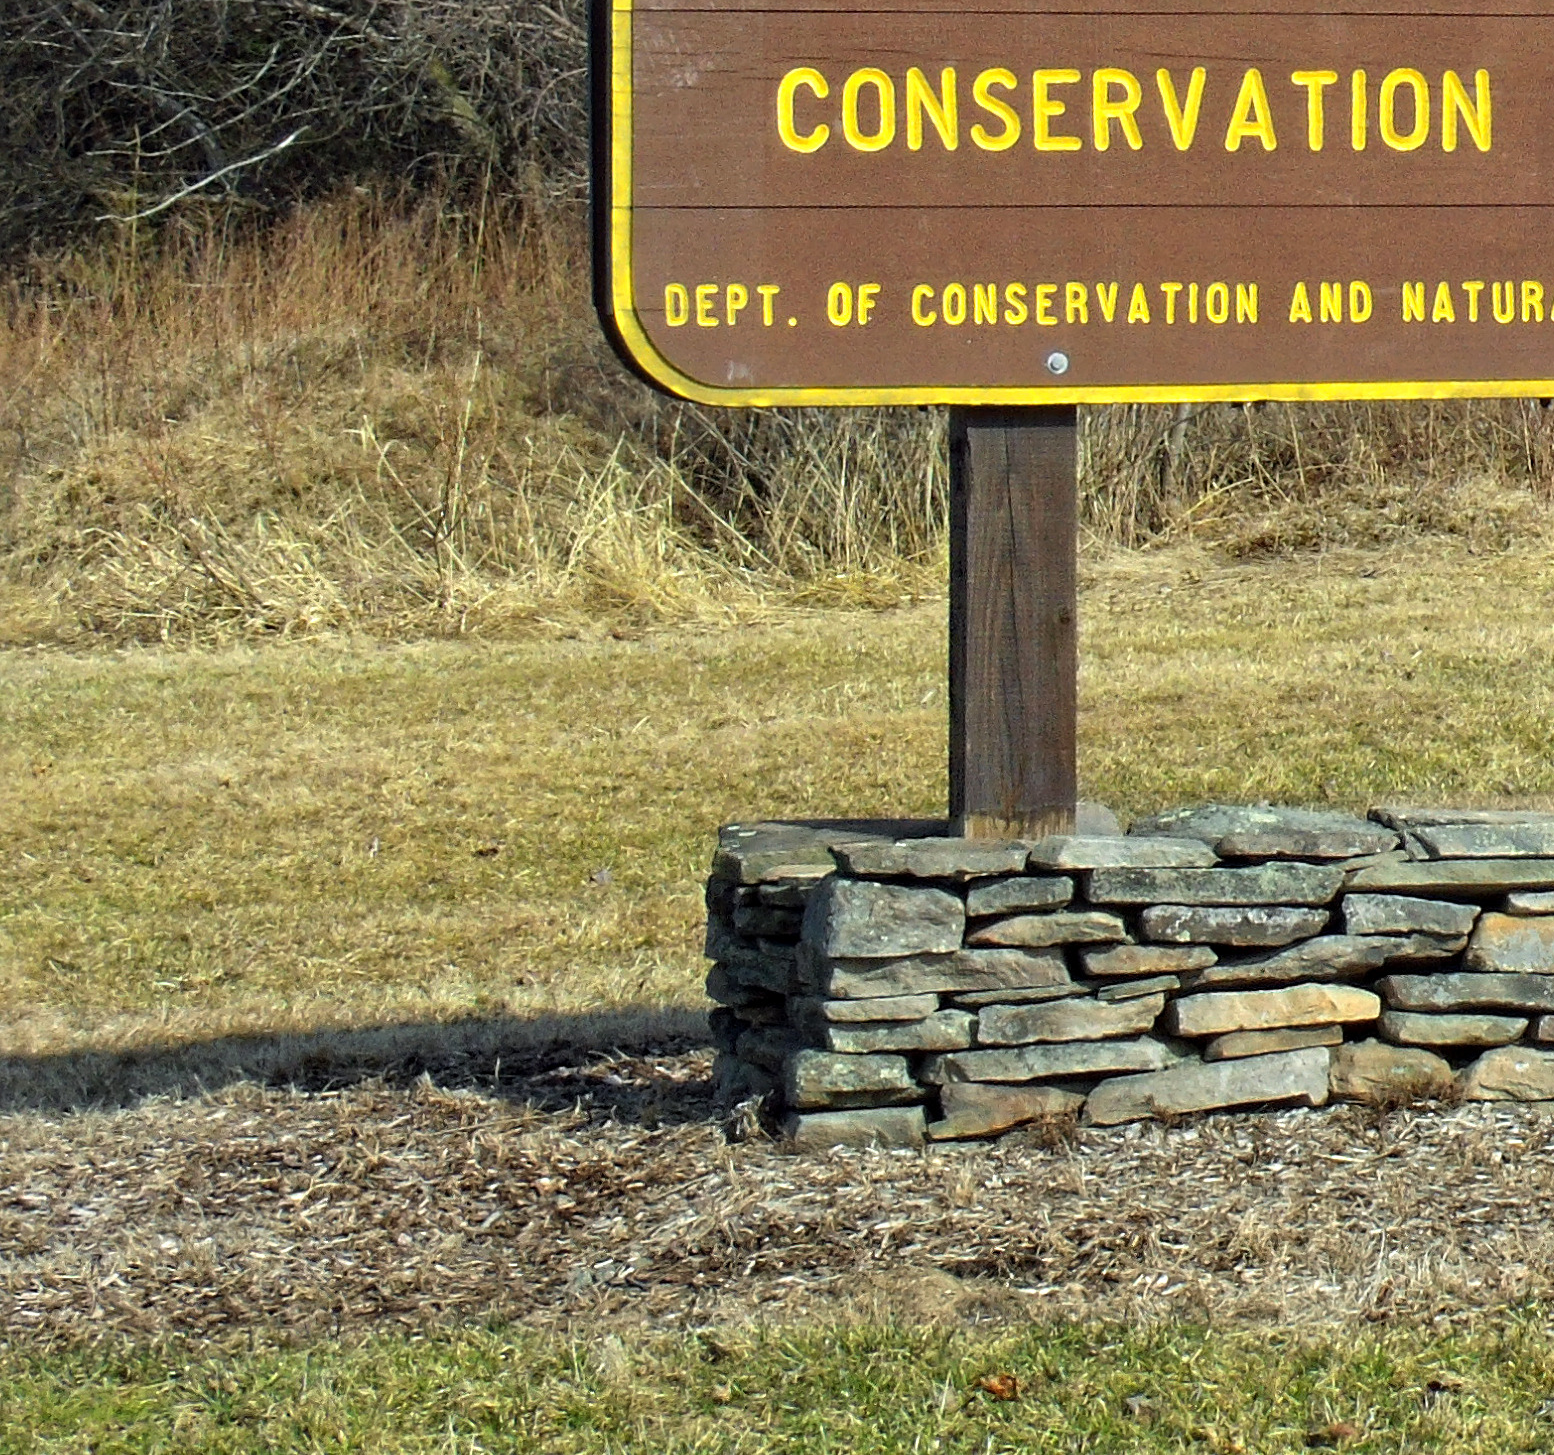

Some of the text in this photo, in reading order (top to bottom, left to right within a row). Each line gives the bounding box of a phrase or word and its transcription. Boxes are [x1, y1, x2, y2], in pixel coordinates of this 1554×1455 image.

[776, 66, 1493, 154] CONSERVATION
[664, 282, 798, 327] DEPT.
[826, 281, 881, 327] OF
[911, 281, 1258, 327] CONSERVATION
[1289, 280, 1373, 324] AND
